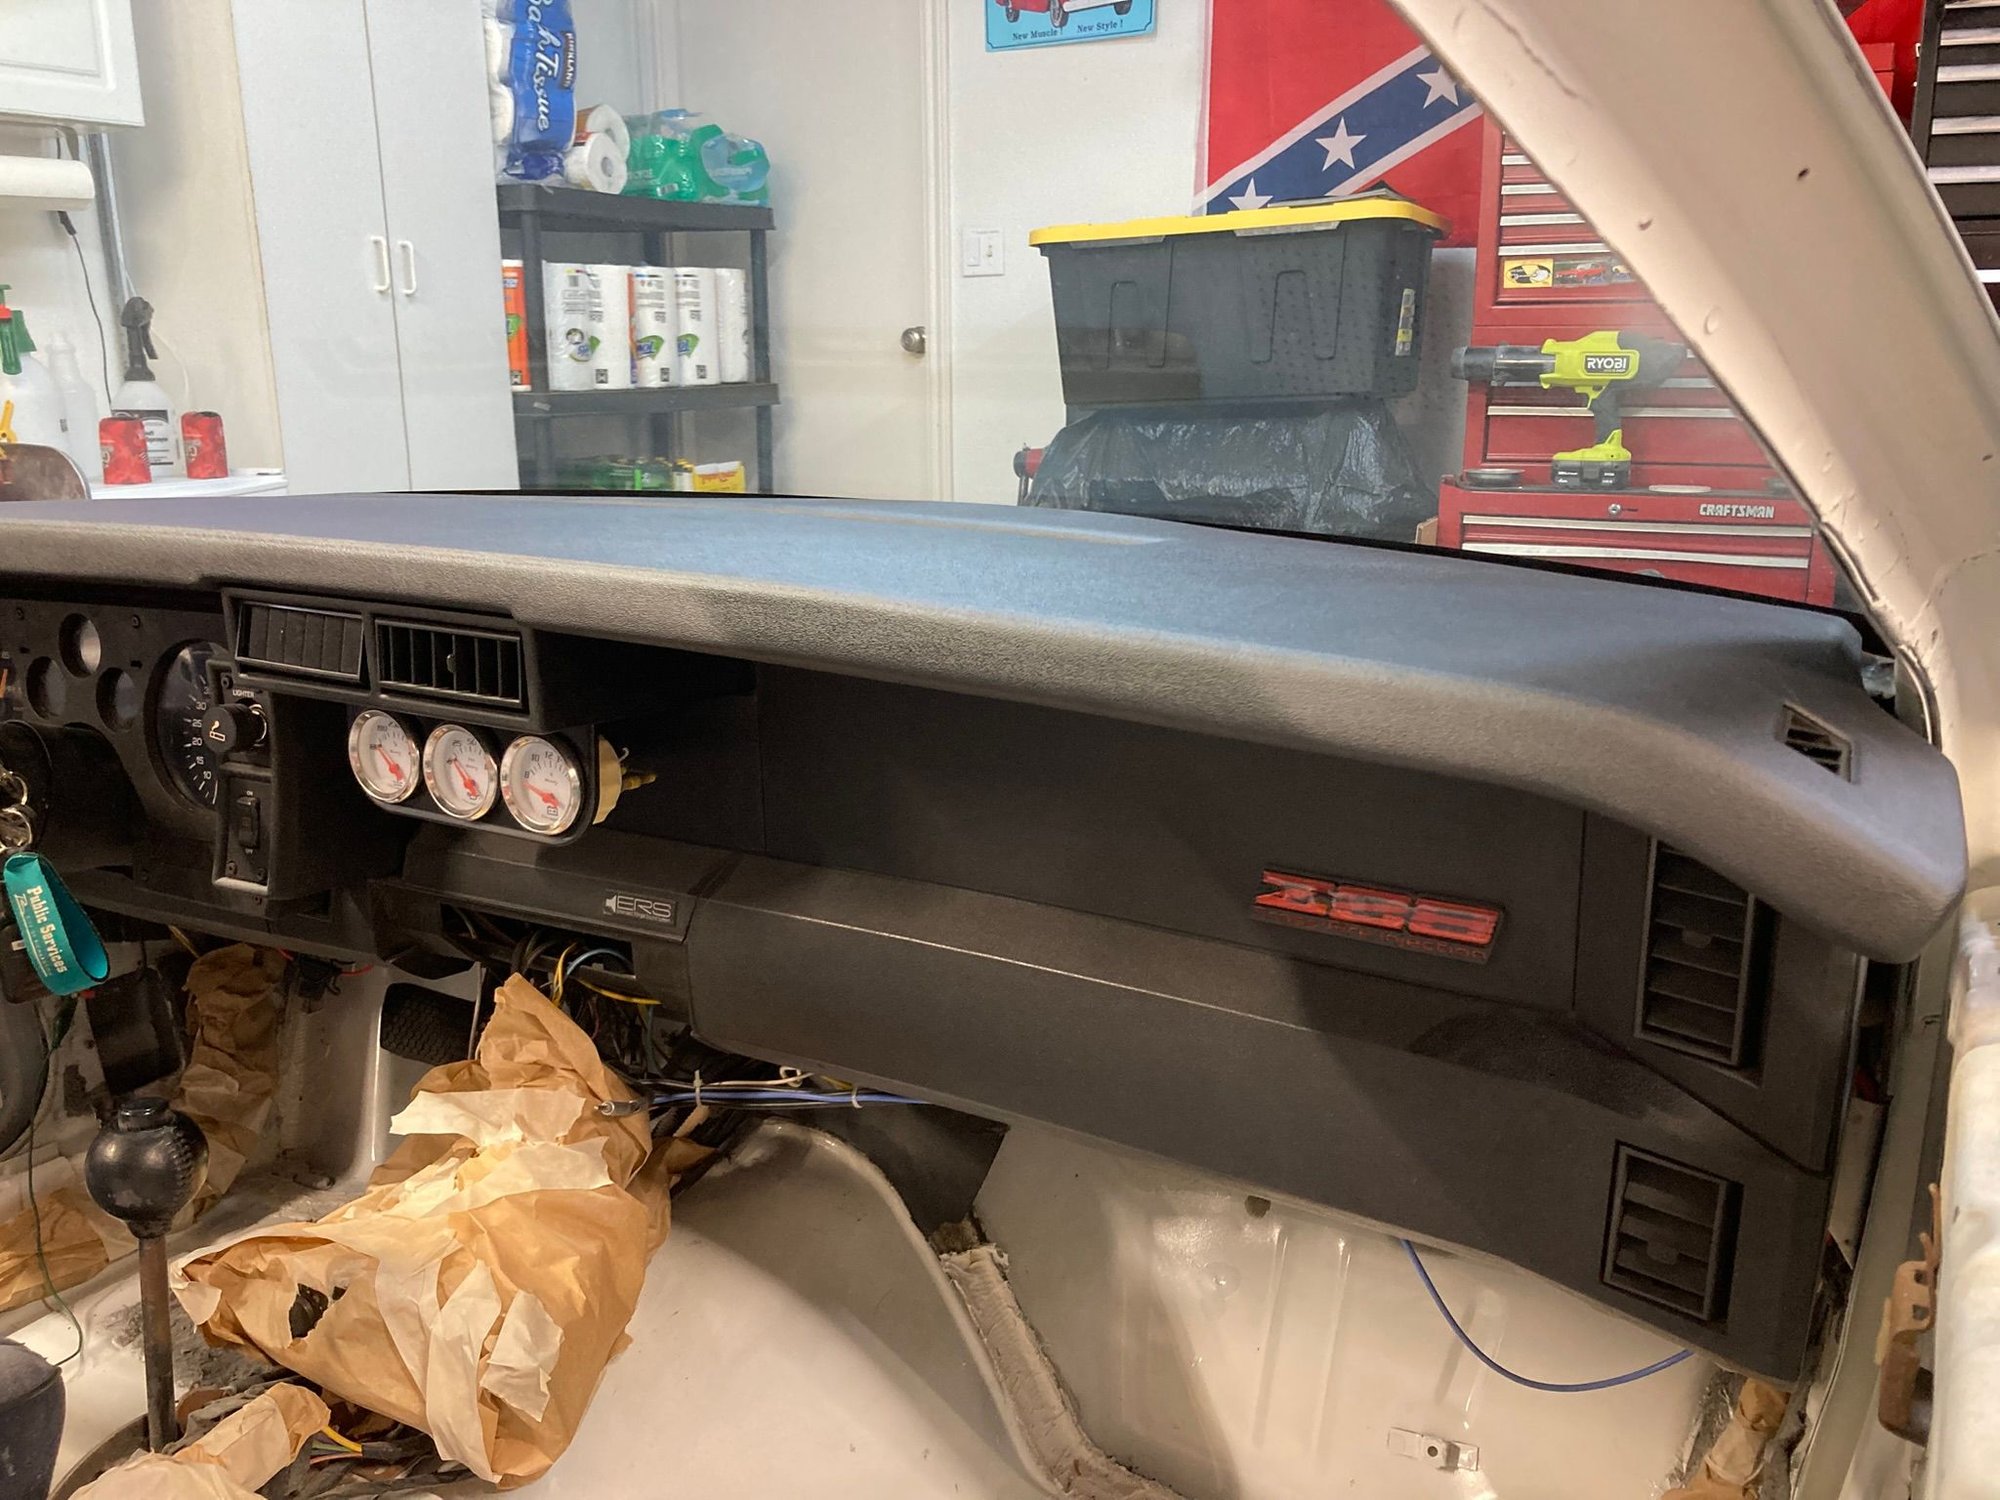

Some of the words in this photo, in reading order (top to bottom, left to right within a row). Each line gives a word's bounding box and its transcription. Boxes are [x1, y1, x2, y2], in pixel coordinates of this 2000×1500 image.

[1012, 32, 1028, 41] New
[1031, 28, 1058, 39] Muscle
[1077, 24, 1094, 33] New
[1096, 20, 1118, 31] Style
[532, 52, 560, 132] Tissue
[1587, 357, 1627, 370] RYOBI
[1699, 503, 1775, 519] CRAFTSMAN
[232, 689, 255, 698] LIGHTER
[196, 702, 207, 711] 30
[192, 719, 202, 728] 25
[192, 737, 203, 746] 20
[531, 753, 540, 762] 10
[545, 751, 553, 760] 12
[196, 756, 204, 765] 15
[203, 770, 212, 780] 10
[524, 771, 530, 779] 8
[617, 895, 673, 919] ERS
[26, 885, 50, 924] Public
[40, 923, 68, 974] Services
